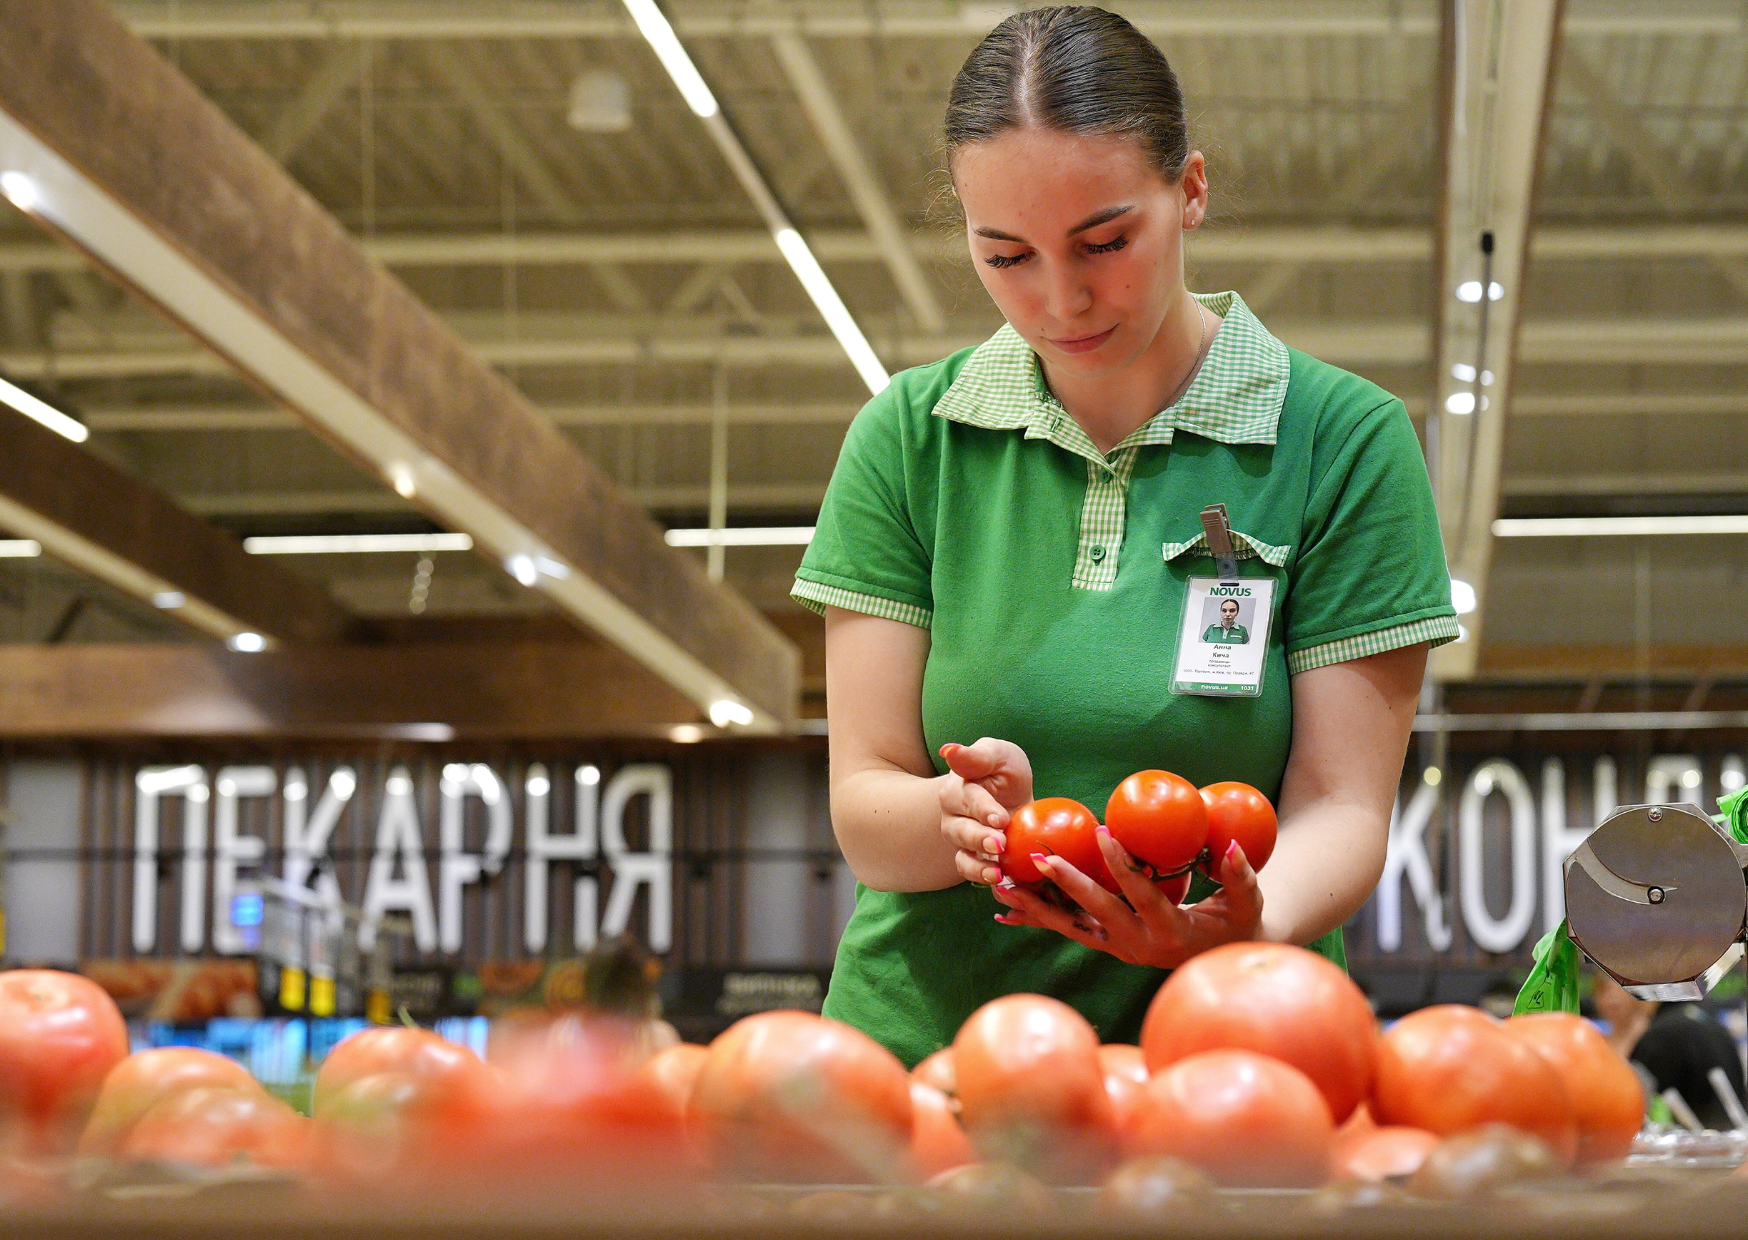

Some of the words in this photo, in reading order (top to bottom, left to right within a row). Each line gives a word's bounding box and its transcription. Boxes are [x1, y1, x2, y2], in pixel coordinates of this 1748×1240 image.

[1210, 587, 1252, 597] NOVUS
[131, 763, 674, 955] ПЕКАРНЯ
[1376, 754, 1748, 953] КОН
